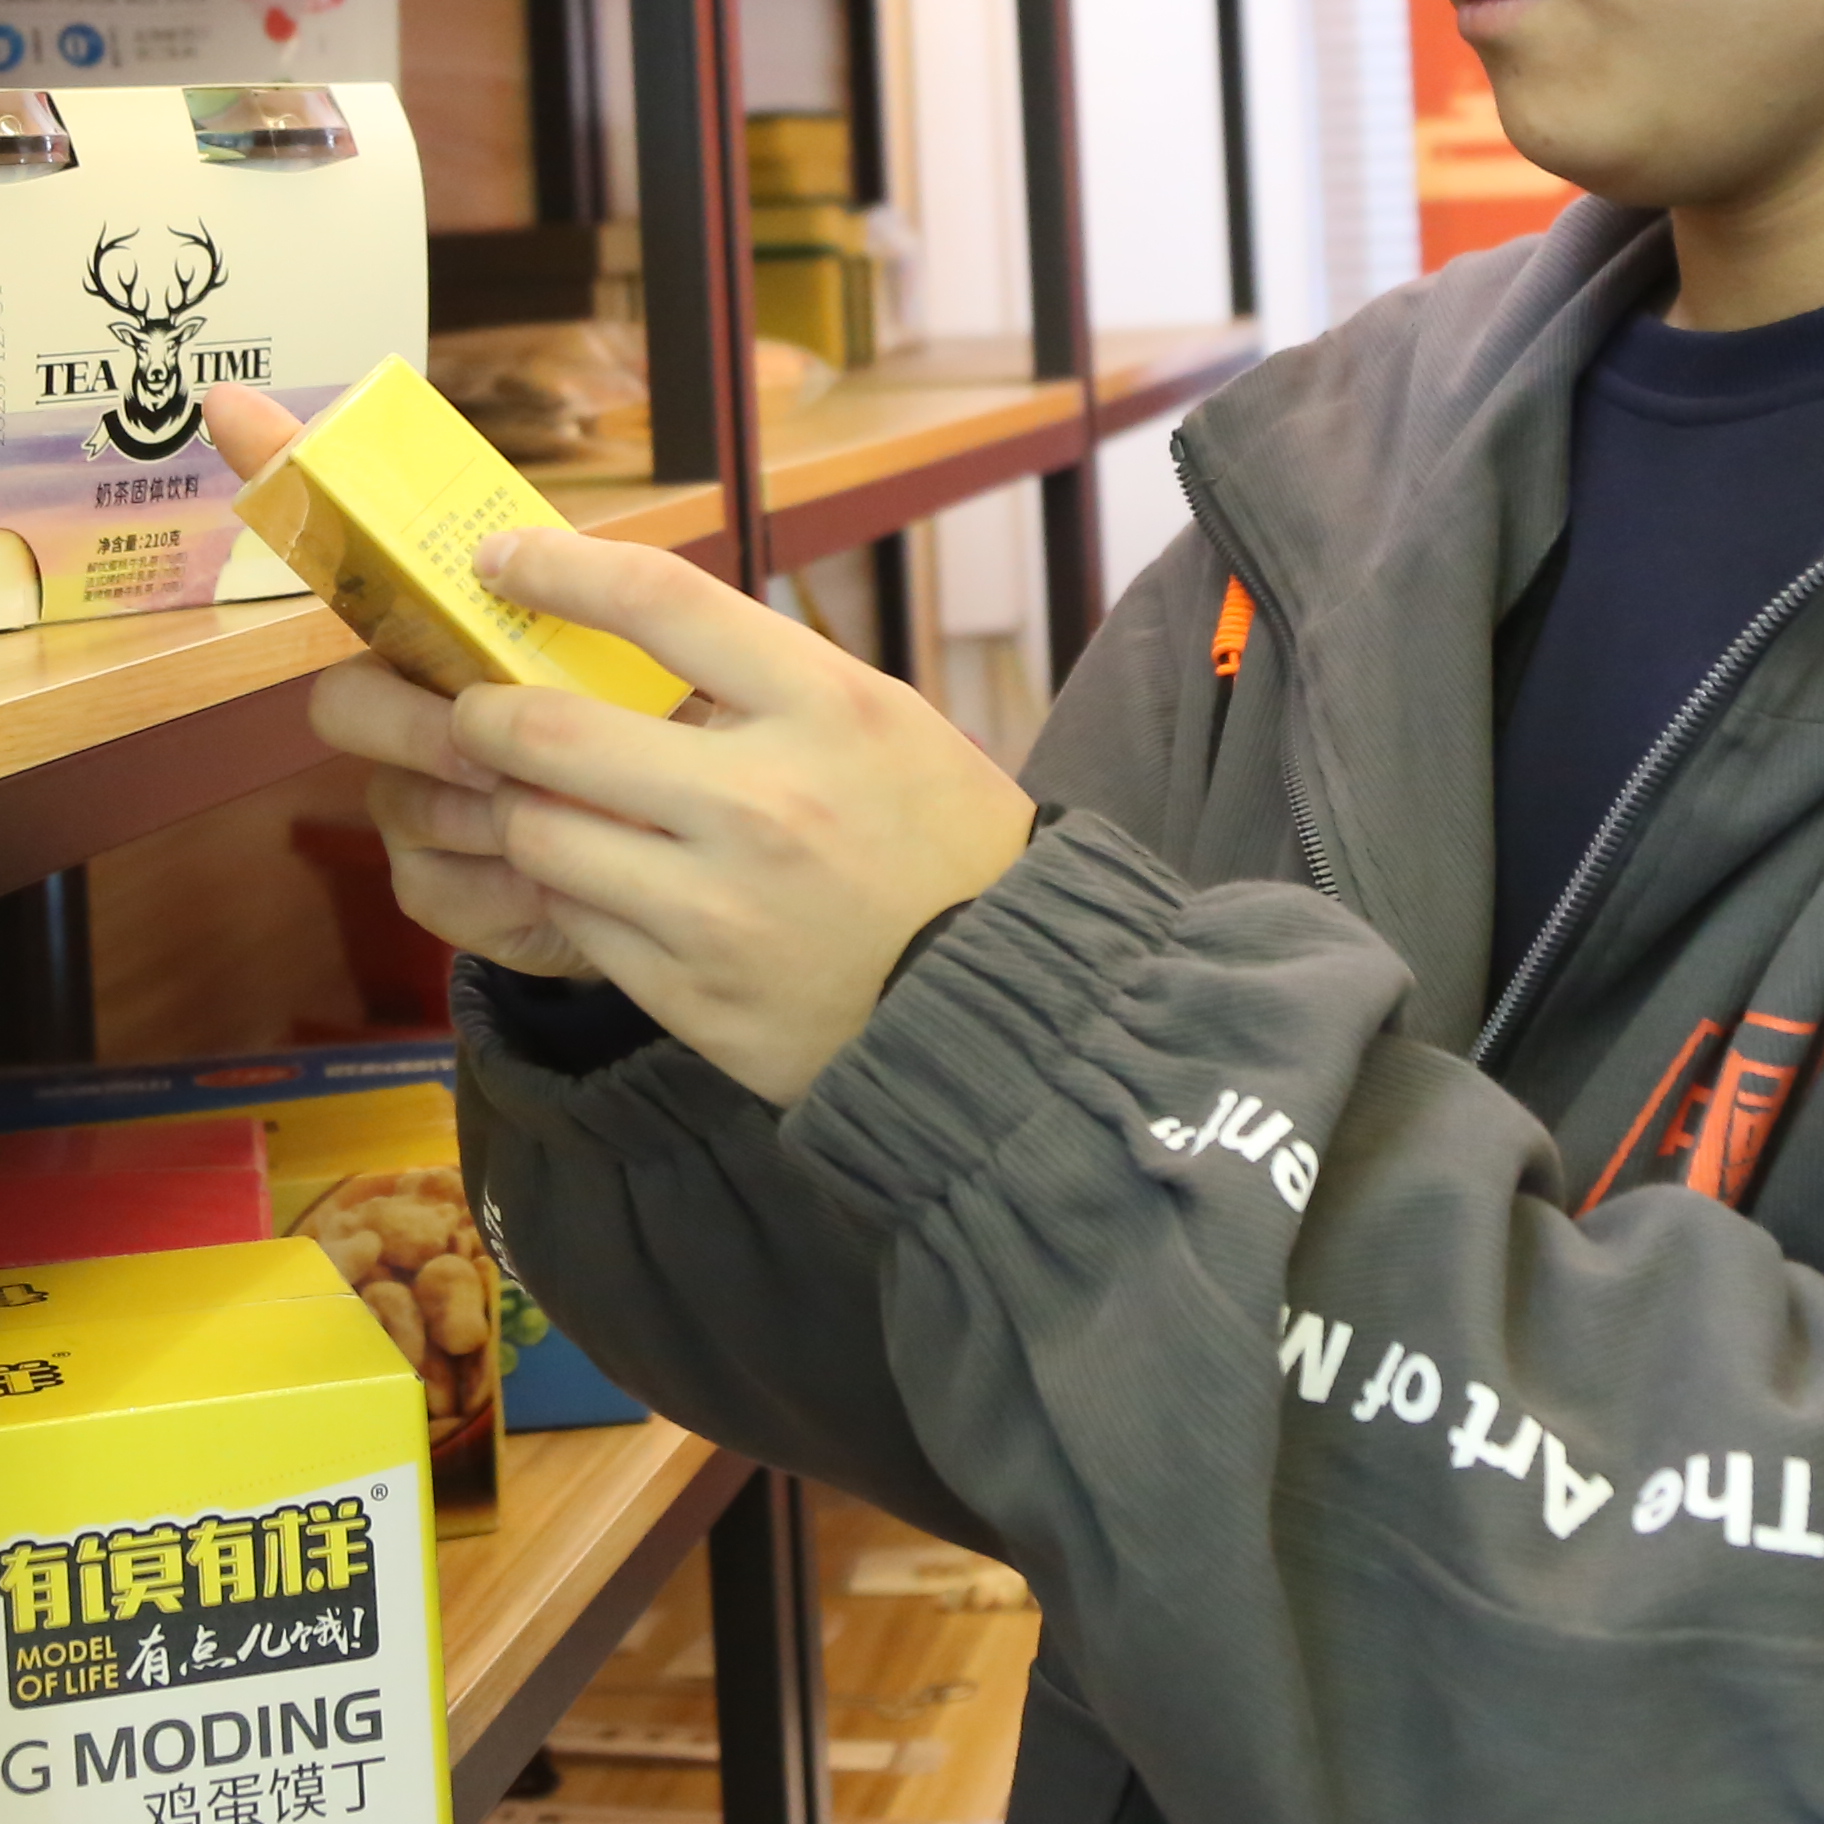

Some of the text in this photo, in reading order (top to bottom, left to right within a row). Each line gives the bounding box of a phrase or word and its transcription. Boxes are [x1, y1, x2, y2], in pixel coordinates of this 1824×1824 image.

[35, 347, 272, 397] TEA TIME
[94, 473, 201, 510] 奶茶固体饮料
[1277, 1302, 1354, 1404] M
[1350, 1340, 1443, 1425] of
[1447, 1379, 1616, 1540] Art
[15, 1636, 118, 1672] MODEL
[16, 1663, 119, 1702] OF LIFE
[73, 1688, 384, 1788] MODING
